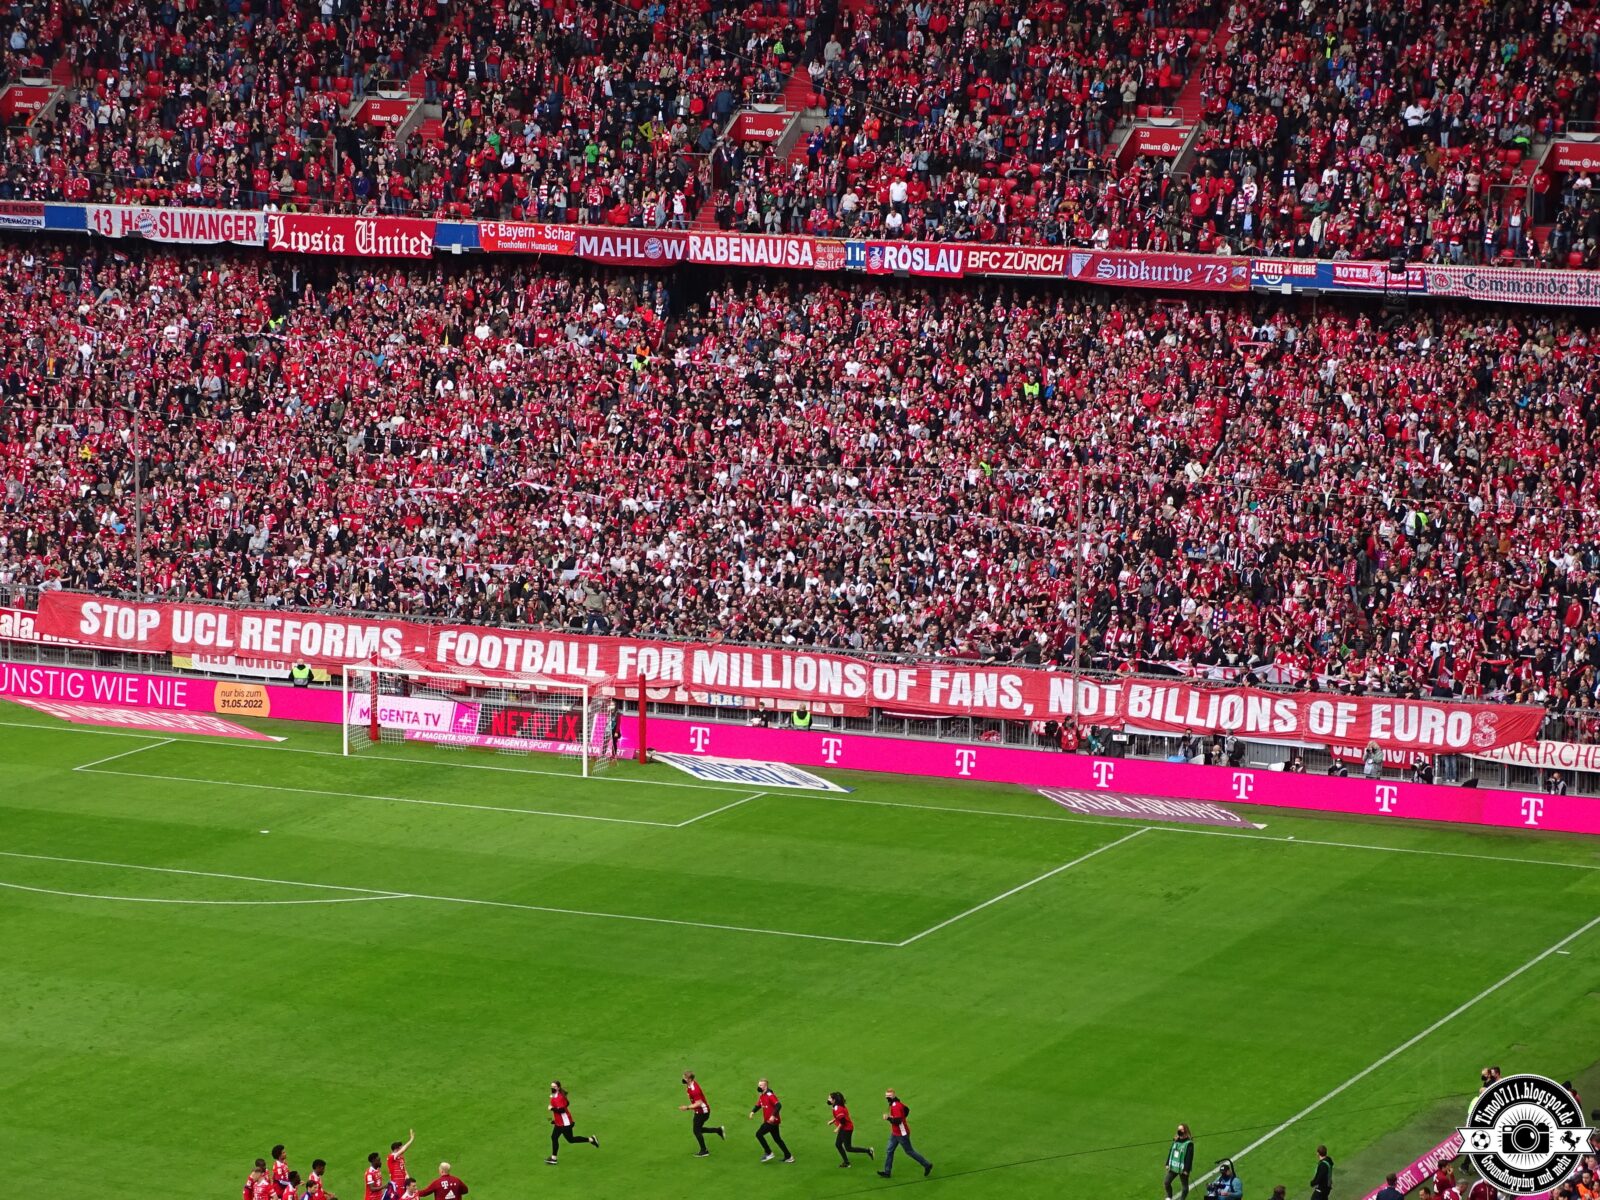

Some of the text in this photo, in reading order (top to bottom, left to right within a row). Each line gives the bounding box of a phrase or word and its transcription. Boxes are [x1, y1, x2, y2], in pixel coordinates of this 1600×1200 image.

[14, 101, 33, 109] Allianz
[371, 114, 391, 122] Allianz
[745, 128, 765, 136] Allianz
[1139, 143, 1161, 151] Allianz
[1558, 158, 1581, 166] Allianz
[94, 209, 113, 235] 13
[268, 215, 433, 257] Lipsia United
[481, 224, 495, 237] FC
[498, 224, 535, 240] Bayern
[544, 227, 575, 242] Schar
[497, 240, 527, 249] Fronhofen
[531, 242, 558, 251] Hunsrück
[688, 235, 814, 267] RABENAU/SA
[884, 245, 963, 273] RÖSLAU
[967, 251, 1001, 269] BFC
[1002, 251, 1065, 272] ZÜRICH
[1096, 257, 1193, 283] Südkurve
[1198, 264, 1228, 284] '73
[1255, 261, 1283, 275] LETZTE
[1292, 263, 1316, 275] REIHE
[1335, 267, 1369, 279] ROTER
[1463, 273, 1569, 295] Commando
[79, 601, 161, 641] STOP
[171, 609, 234, 648] UCL
[240, 615, 403, 661] REFORMS
[436, 630, 607, 678] FOOTBALL
[617, 645, 685, 682] FOR
[692, 649, 866, 698] MILLIONS
[872, 668, 918, 701] OF
[929, 669, 1034, 717] FANS,
[1048, 677, 1122, 717] NOT
[1128, 684, 1298, 733] BILLIONS
[1309, 700, 1358, 738] OF
[1370, 703, 1498, 748] EUROS
[91, 674, 139, 703] WIE
[147, 679, 188, 707] NIE
[234, 689, 245, 698] bis
[246, 690, 262, 698] zum
[221, 699, 263, 709] 31.05.2022
[359, 707, 441, 727] MGENTA TV
[491, 710, 579, 742] NETFLIX
[422, 732, 480, 743] MAGENTA SPORT
[493, 738, 553, 750] MAGENTA SPORT
